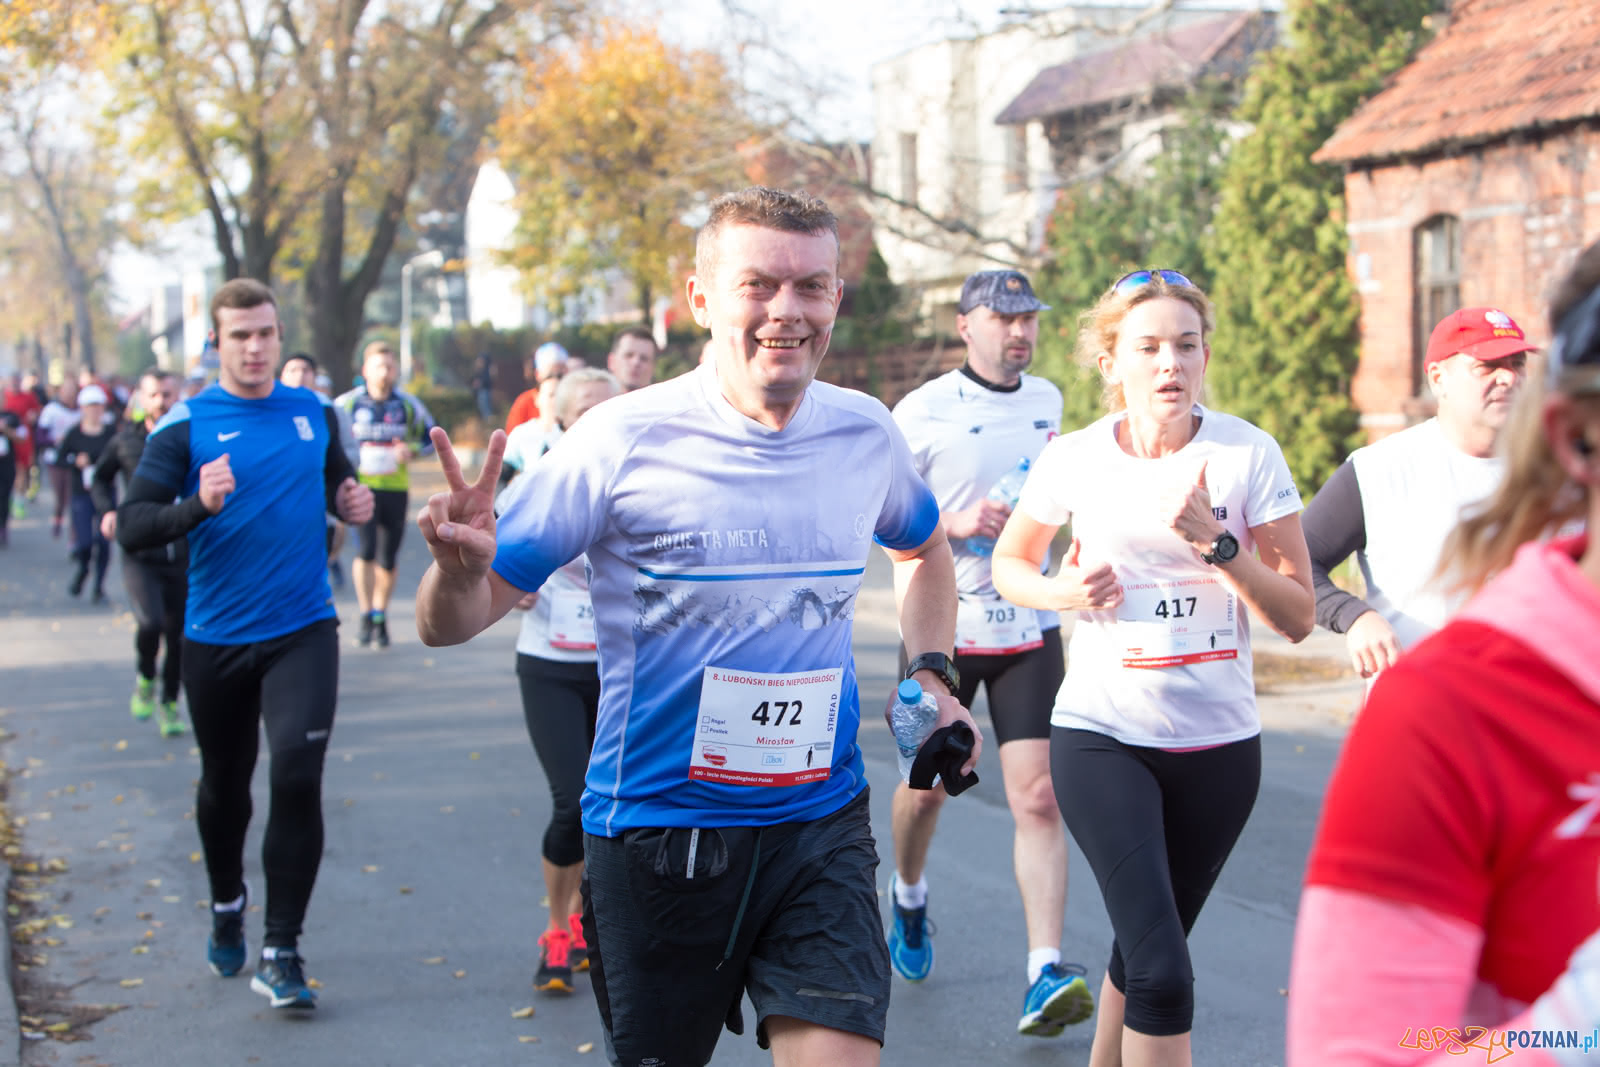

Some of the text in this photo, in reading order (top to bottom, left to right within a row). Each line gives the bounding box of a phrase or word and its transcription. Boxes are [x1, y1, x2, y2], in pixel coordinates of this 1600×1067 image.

[654, 528, 768, 550] GDZIE TA META
[985, 607, 1016, 623] 703
[1155, 597, 1197, 619] 417
[712, 673, 836, 687] 8. LUBOŃSKI BIEG NIEPODLEGŁOŚCI
[751, 700, 803, 727] 472
[827, 703, 837, 732] STREFA
[756, 736, 795, 746] Mirosław
